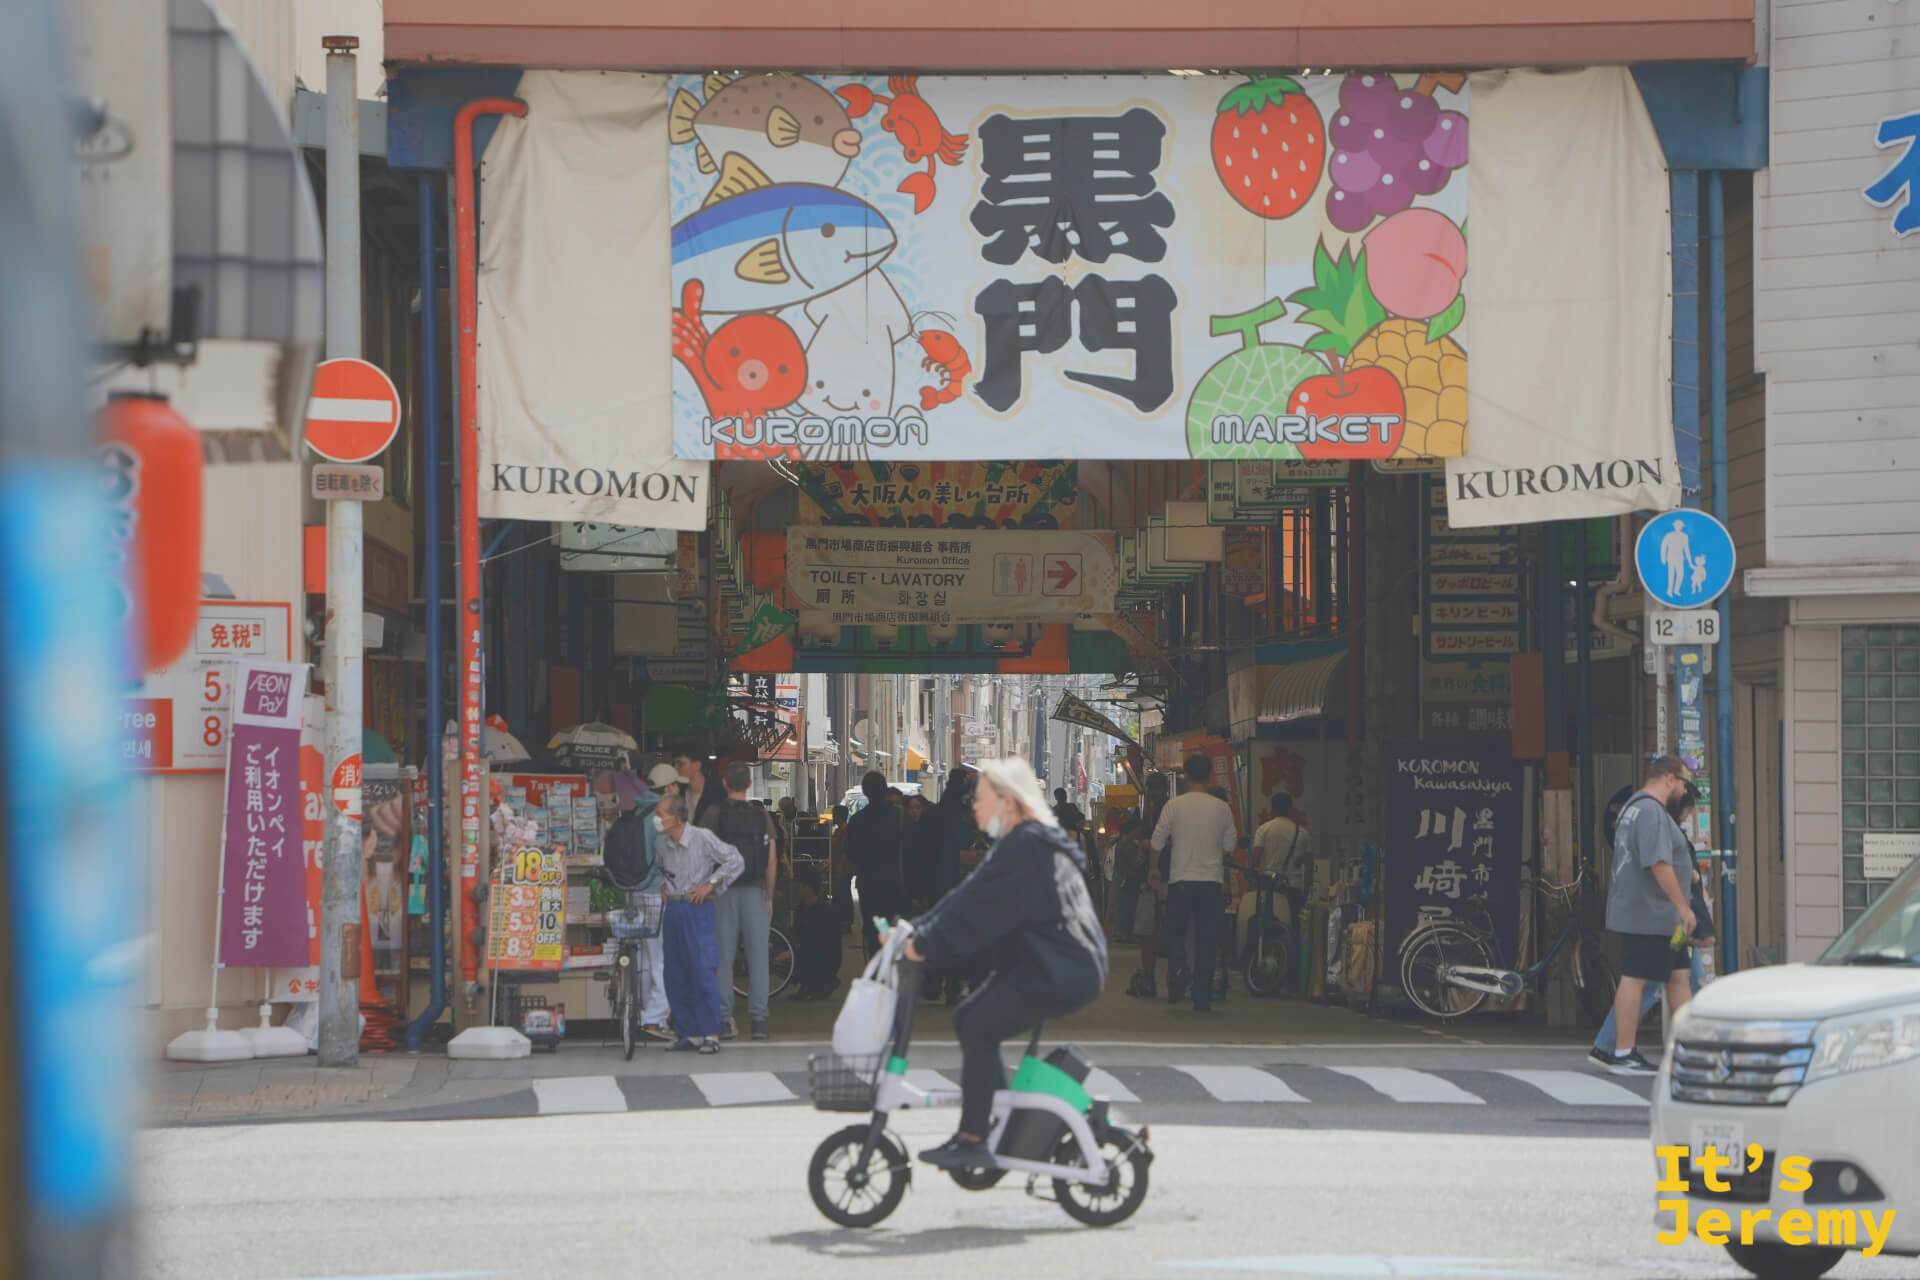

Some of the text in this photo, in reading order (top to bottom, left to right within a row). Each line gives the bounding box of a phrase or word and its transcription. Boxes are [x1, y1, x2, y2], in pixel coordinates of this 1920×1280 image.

[968, 106, 1177, 413] 黒門
[701, 415, 929, 446] KUROMON
[1209, 412, 1402, 444] MARKET
[491, 463, 700, 504] KUROMON
[1455, 456, 1662, 501] KUROMON
[850, 482, 1030, 506] 大阪人の美しい台所
[896, 555, 971, 566] Kuromon Office
[810, 570, 966, 586] TOILET LAVATORY
[1435, 576, 1514, 591] サッポロビール
[1435, 606, 1514, 619] キリンビール
[211, 623, 252, 649] 免税
[1656, 618, 1714, 636] 12 18
[1435, 635, 1515, 649] サントリービール
[575, 745, 611, 754] POLICE
[1413, 775, 1513, 798] Kawasakiya
[264, 746, 297, 858] イオンペイ
[242, 743, 267, 950] ご利用いただけます
